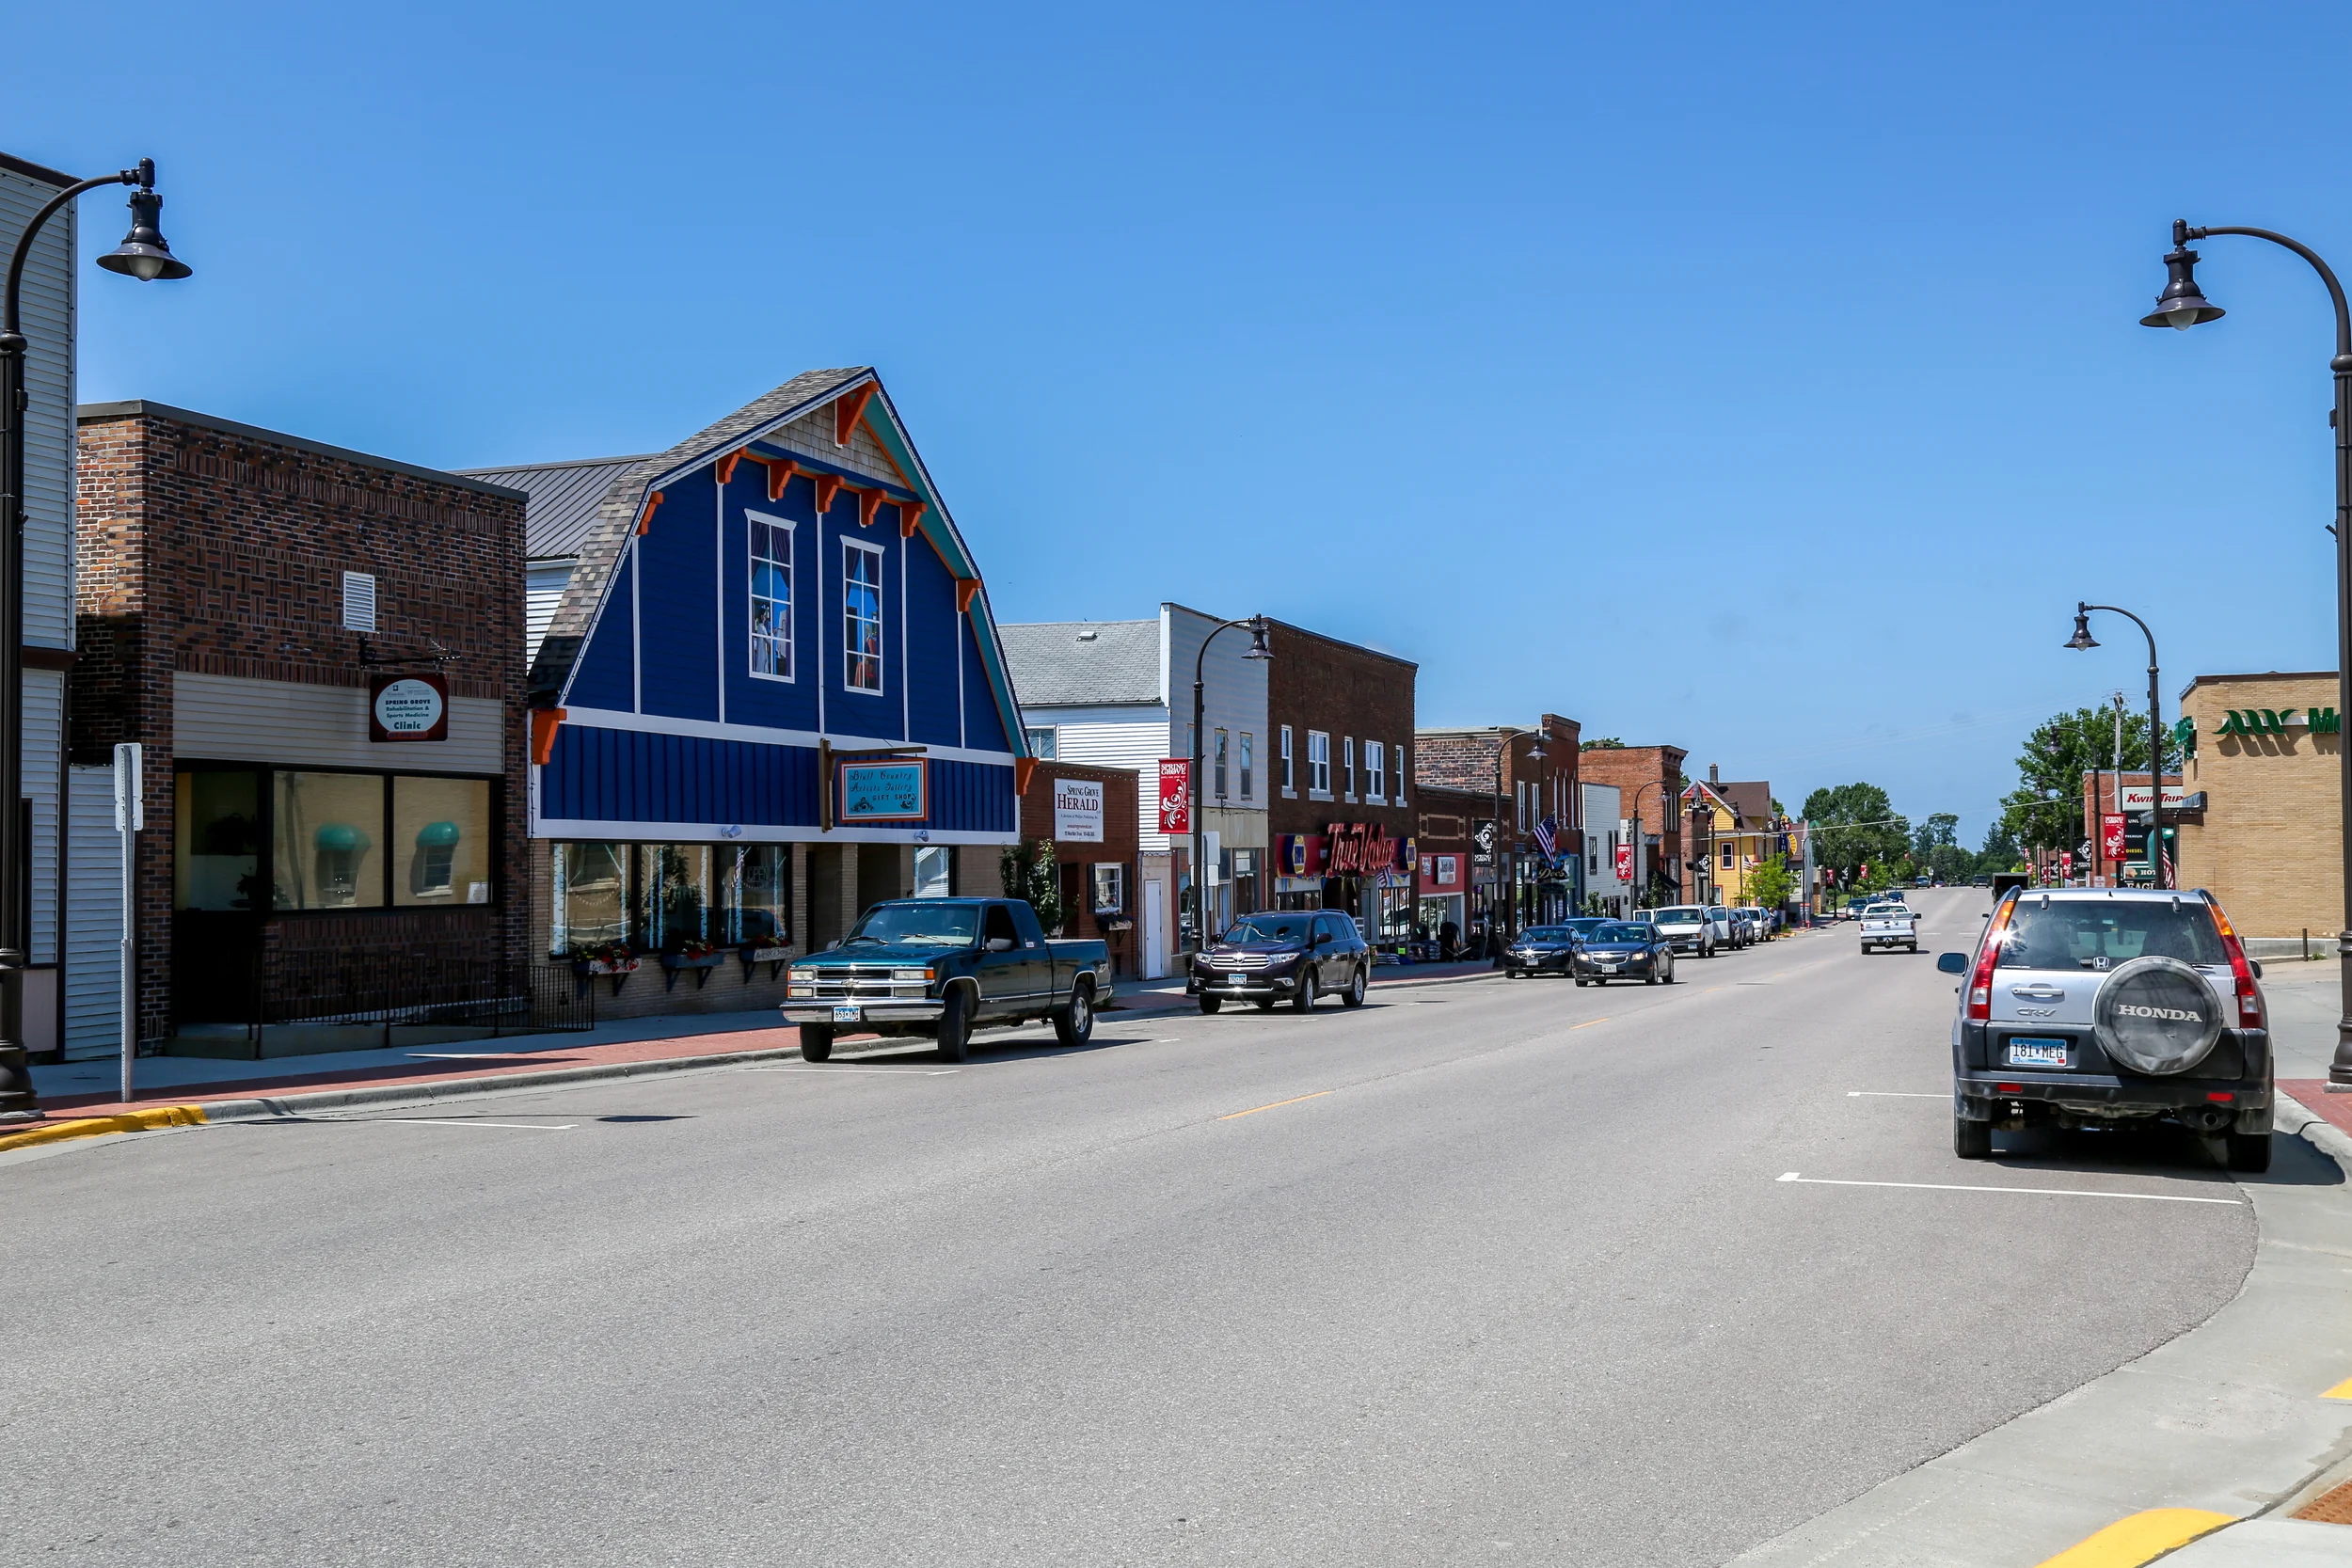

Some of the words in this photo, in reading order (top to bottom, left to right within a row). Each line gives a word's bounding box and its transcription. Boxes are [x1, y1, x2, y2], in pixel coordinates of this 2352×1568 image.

[393, 721, 421, 730] Clinic
[880, 770, 912, 781] Country
[1067, 784, 1084, 797] SPRING
[1084, 786, 1099, 798] GROVE
[1057, 793, 1099, 811] HERALD
[1326, 823, 1359, 878] True
[1351, 823, 1395, 872] Value
[2016, 1006, 2057, 1017] CR-V
[2118, 1004, 2202, 1022] HONDA
[2013, 1044, 2033, 1058] 181
[2042, 1045, 2063, 1059] MEG
